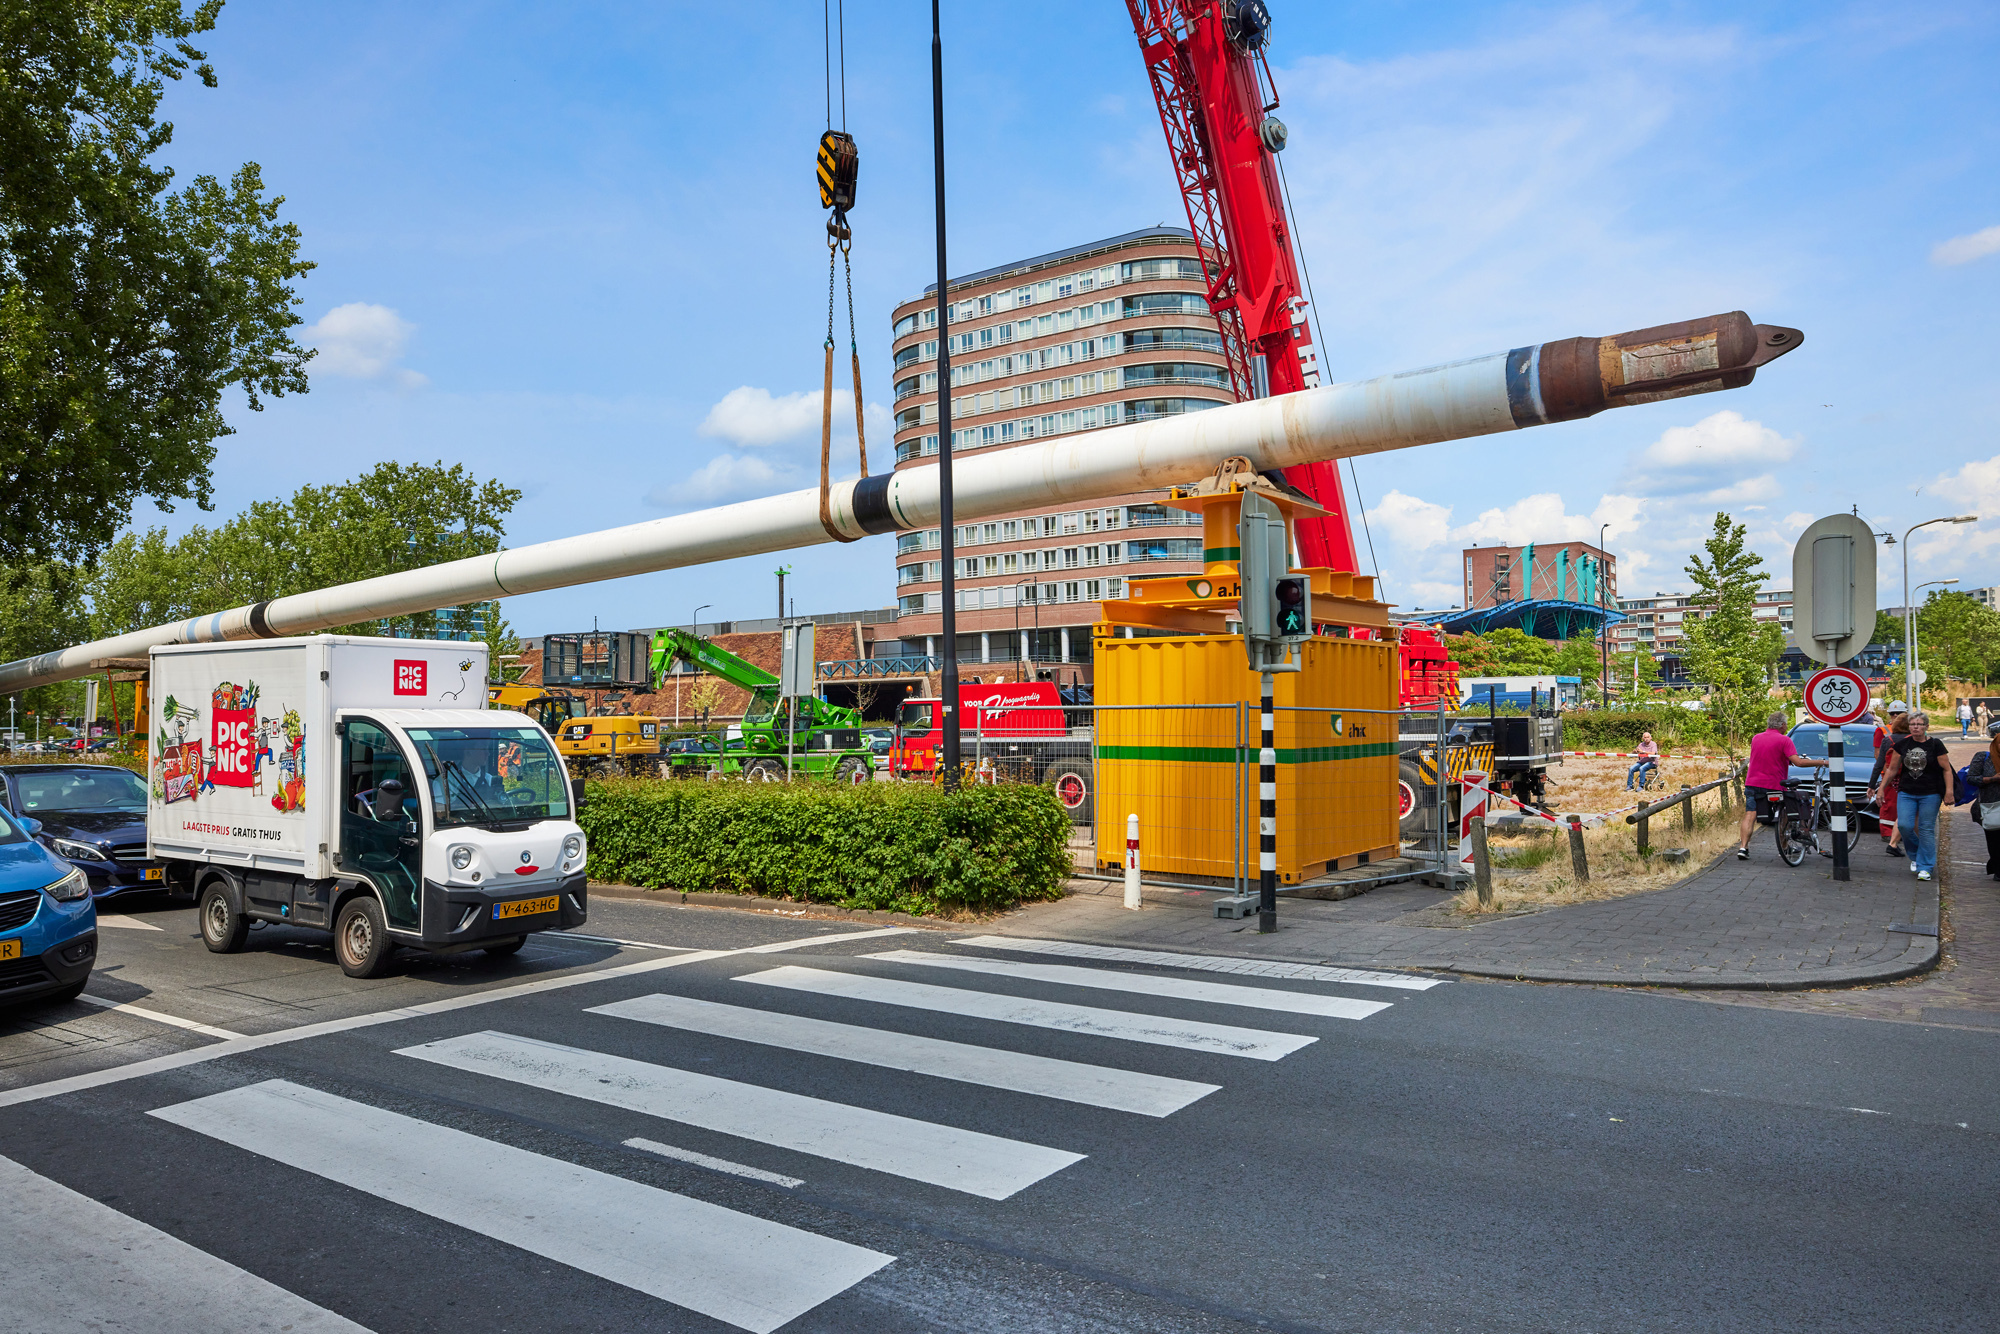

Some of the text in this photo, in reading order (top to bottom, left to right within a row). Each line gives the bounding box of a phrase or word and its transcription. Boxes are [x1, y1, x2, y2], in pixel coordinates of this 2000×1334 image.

[399, 666, 422, 678] PIC
[217, 721, 249, 747] PIC
[573, 726, 585, 734] CAT
[643, 724, 655, 738] CAT
[183, 821, 281, 841] LAAGSTE PRIJS GRATIS THUIS
[503, 899, 555, 916] V-463-HG
